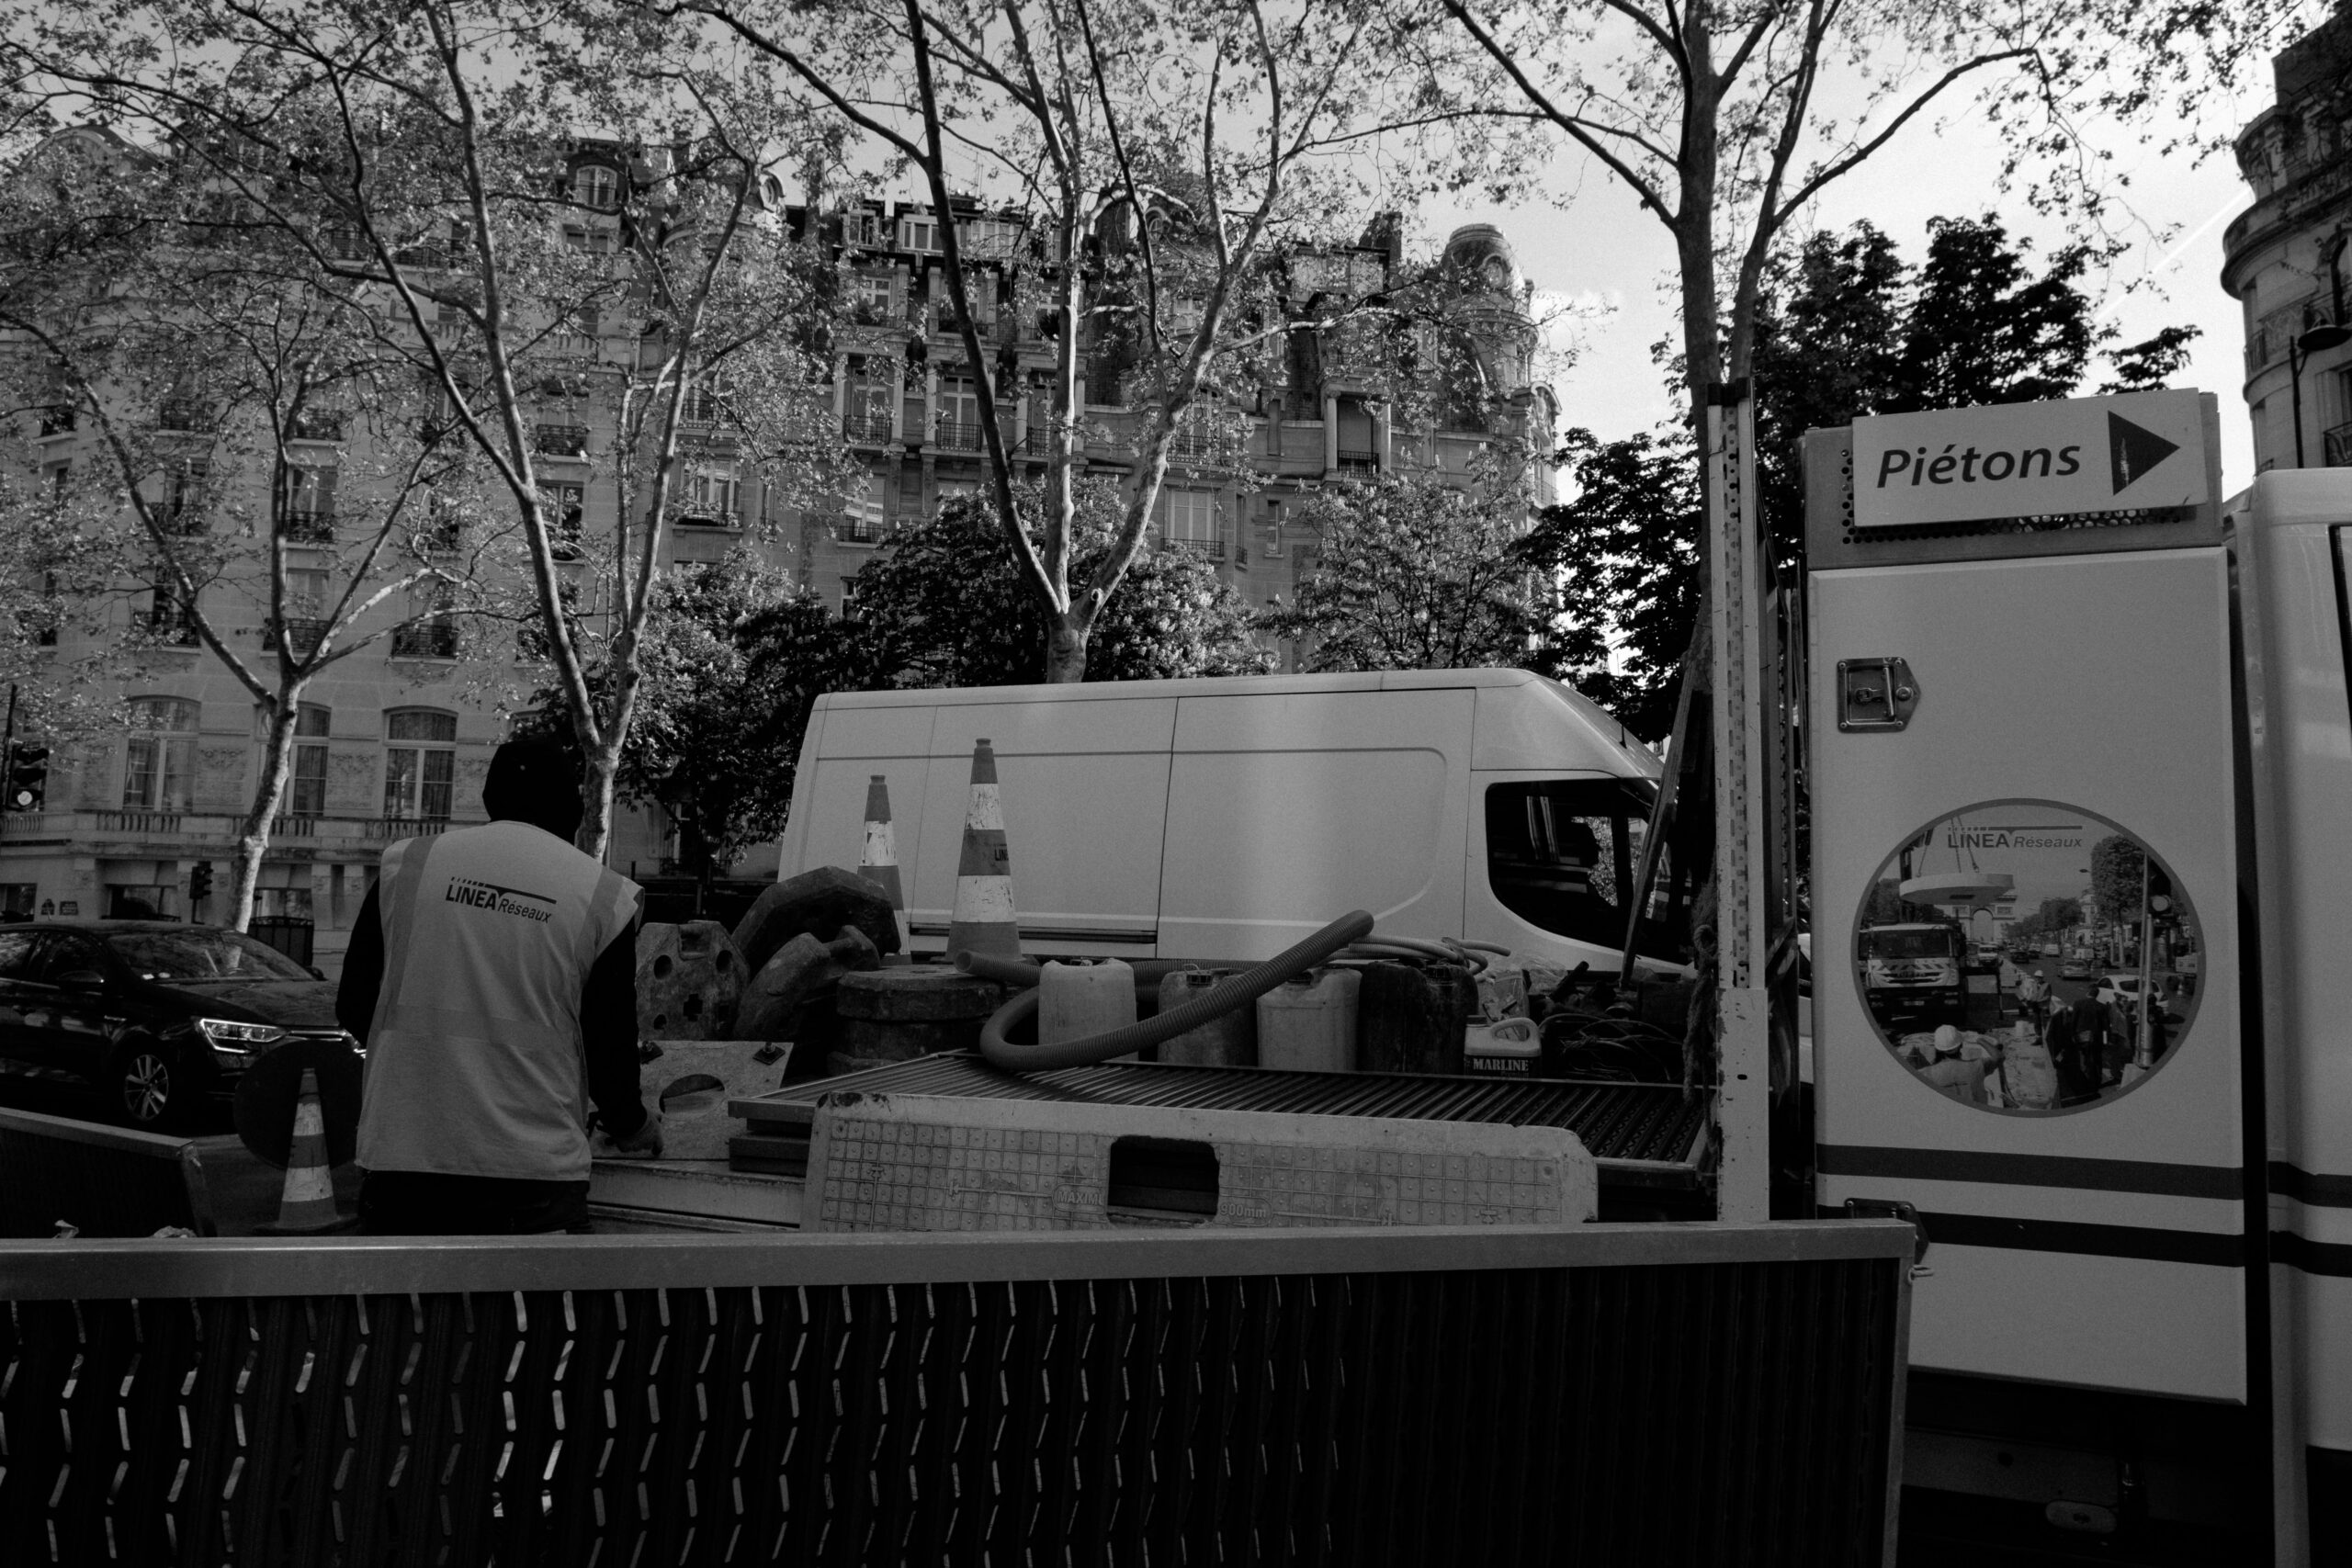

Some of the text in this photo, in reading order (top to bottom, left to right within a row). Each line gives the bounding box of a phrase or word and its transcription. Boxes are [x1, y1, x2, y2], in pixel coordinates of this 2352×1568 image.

[1876, 444, 2080, 488] Piétons
[1948, 833, 2082, 848] LINEA Réseaux
[446, 885, 552, 924] LINEA Réseaux
[1473, 1058, 1529, 1071] MARLINE
